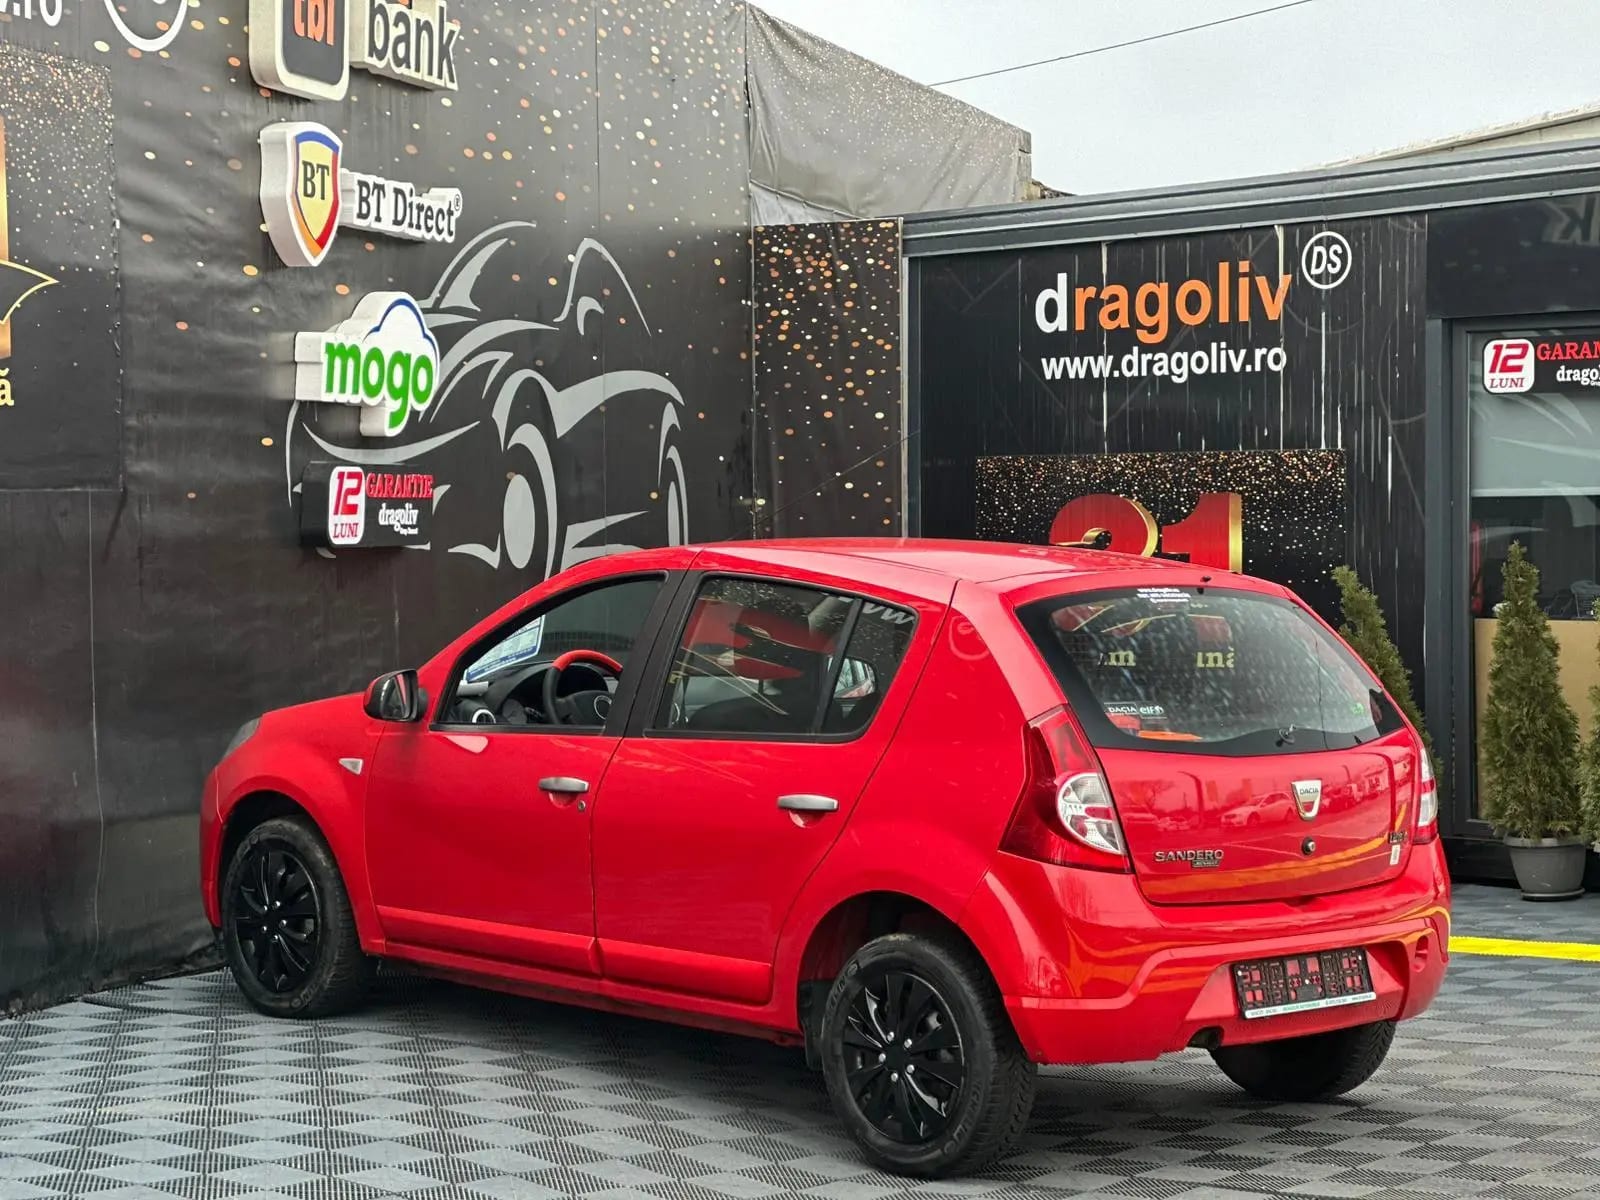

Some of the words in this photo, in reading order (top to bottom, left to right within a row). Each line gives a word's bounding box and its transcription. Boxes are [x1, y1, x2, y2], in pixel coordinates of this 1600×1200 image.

[368, 0, 456, 84] bank
[302, 160, 330, 200] BT
[356, 179, 386, 224] BT
[392, 187, 454, 237] Direct
[1310, 244, 1342, 275] DS
[1035, 260, 1292, 344] dragoliv
[1041, 342, 1287, 384] www.dragoliv.ro
[1488, 343, 1530, 373] 12
[325, 341, 434, 429] mogo
[1490, 378, 1525, 389] LUNI
[333, 471, 363, 516] 12
[366, 472, 433, 498] GARANTIE
[333, 523, 359, 538] LUNI
[378, 502, 419, 532] dragoliv
[1155, 849, 1224, 862] SANDERO
